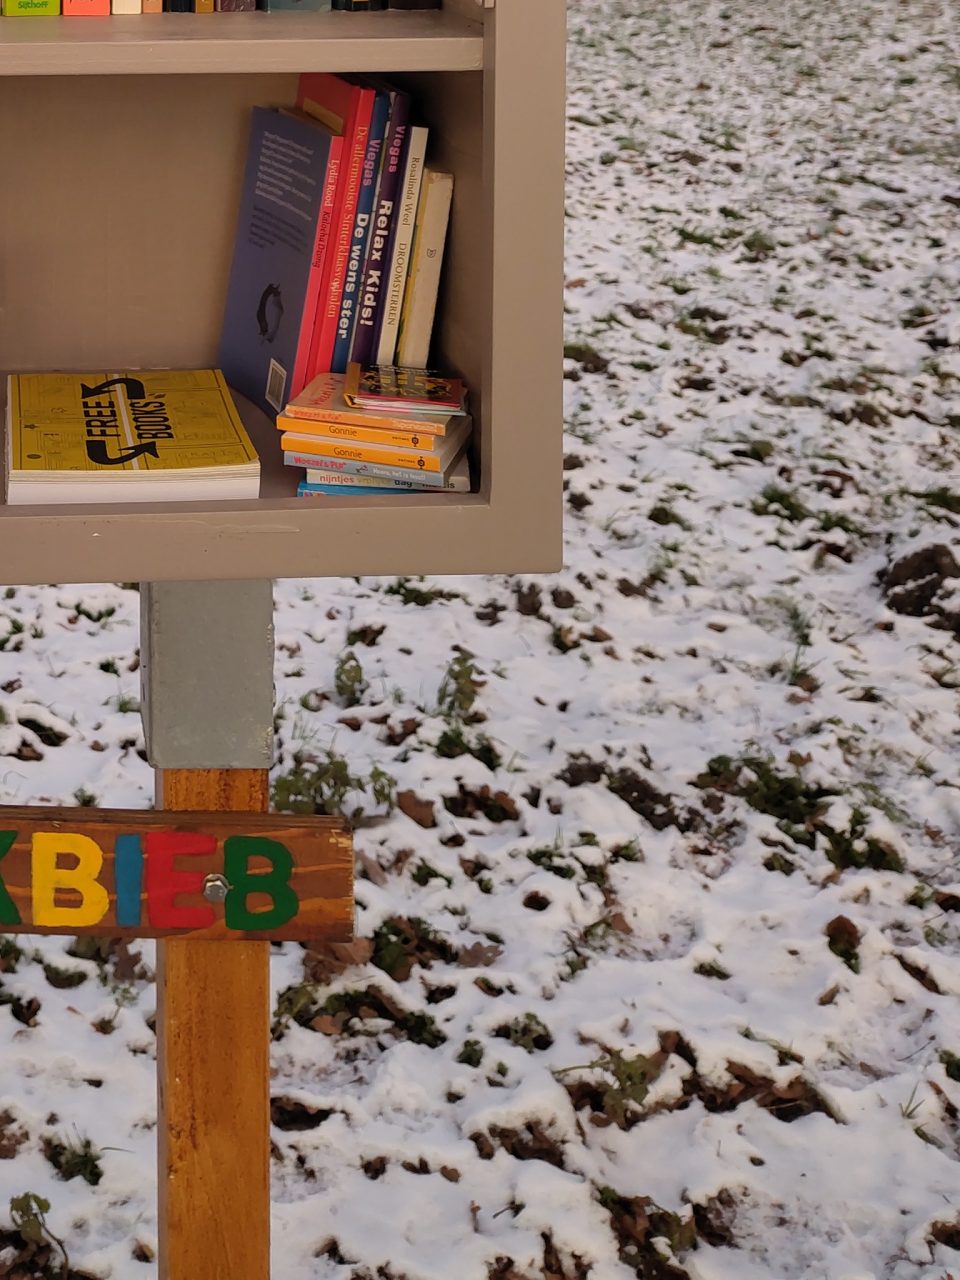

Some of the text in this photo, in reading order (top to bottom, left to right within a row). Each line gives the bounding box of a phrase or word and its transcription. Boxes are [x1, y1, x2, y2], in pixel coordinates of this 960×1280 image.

[359, 126, 368, 142] De
[389, 126, 406, 173] Viegas
[324, 159, 340, 207] Lydia Rood
[342, 143, 363, 210] allermooiste
[362, 139, 381, 186] Viegas
[406, 157, 420, 200] Rosalinda
[354, 213, 370, 238] De
[345, 244, 362, 293] wens
[359, 200, 393, 327] Relax Kids!
[387, 243, 408, 325] DROOMSTERREN
[338, 299, 353, 339] ster
[82, 400, 121, 438] FREE
[129, 401, 174, 439] BOOKS
[329, 425, 358, 437] Gonnie
[333, 447, 363, 459] Gonnie
[320, 474, 354, 484] nijntjes
